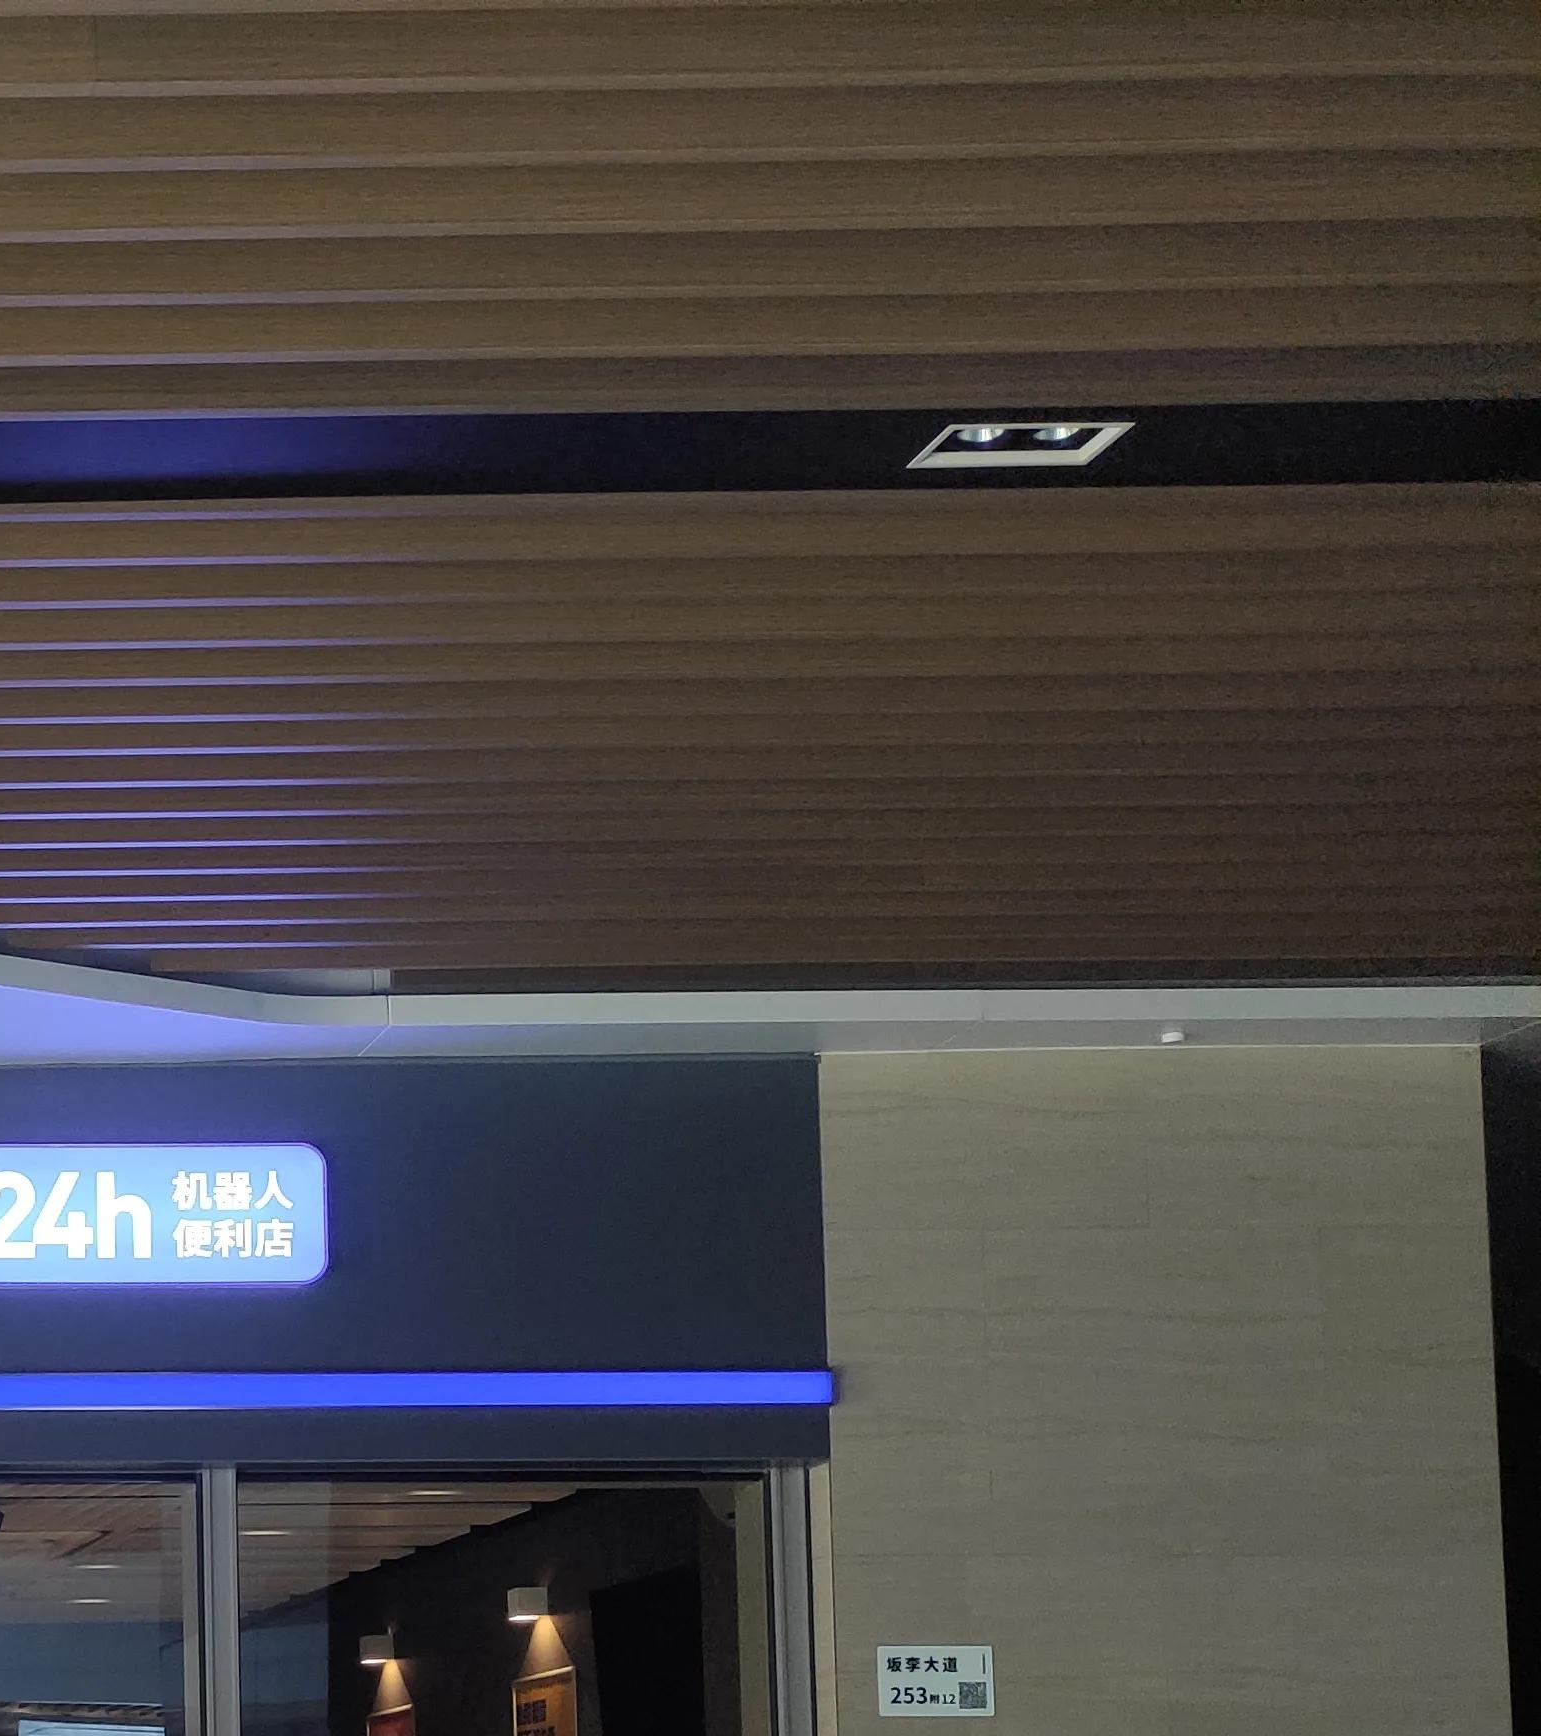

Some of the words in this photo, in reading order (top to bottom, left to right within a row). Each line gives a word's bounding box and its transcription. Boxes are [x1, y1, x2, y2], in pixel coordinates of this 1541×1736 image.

[171, 1170, 294, 1211] 机器人
[171, 1219, 294, 1259] 便利店
[887, 1656, 959, 1673] 坂李大道
